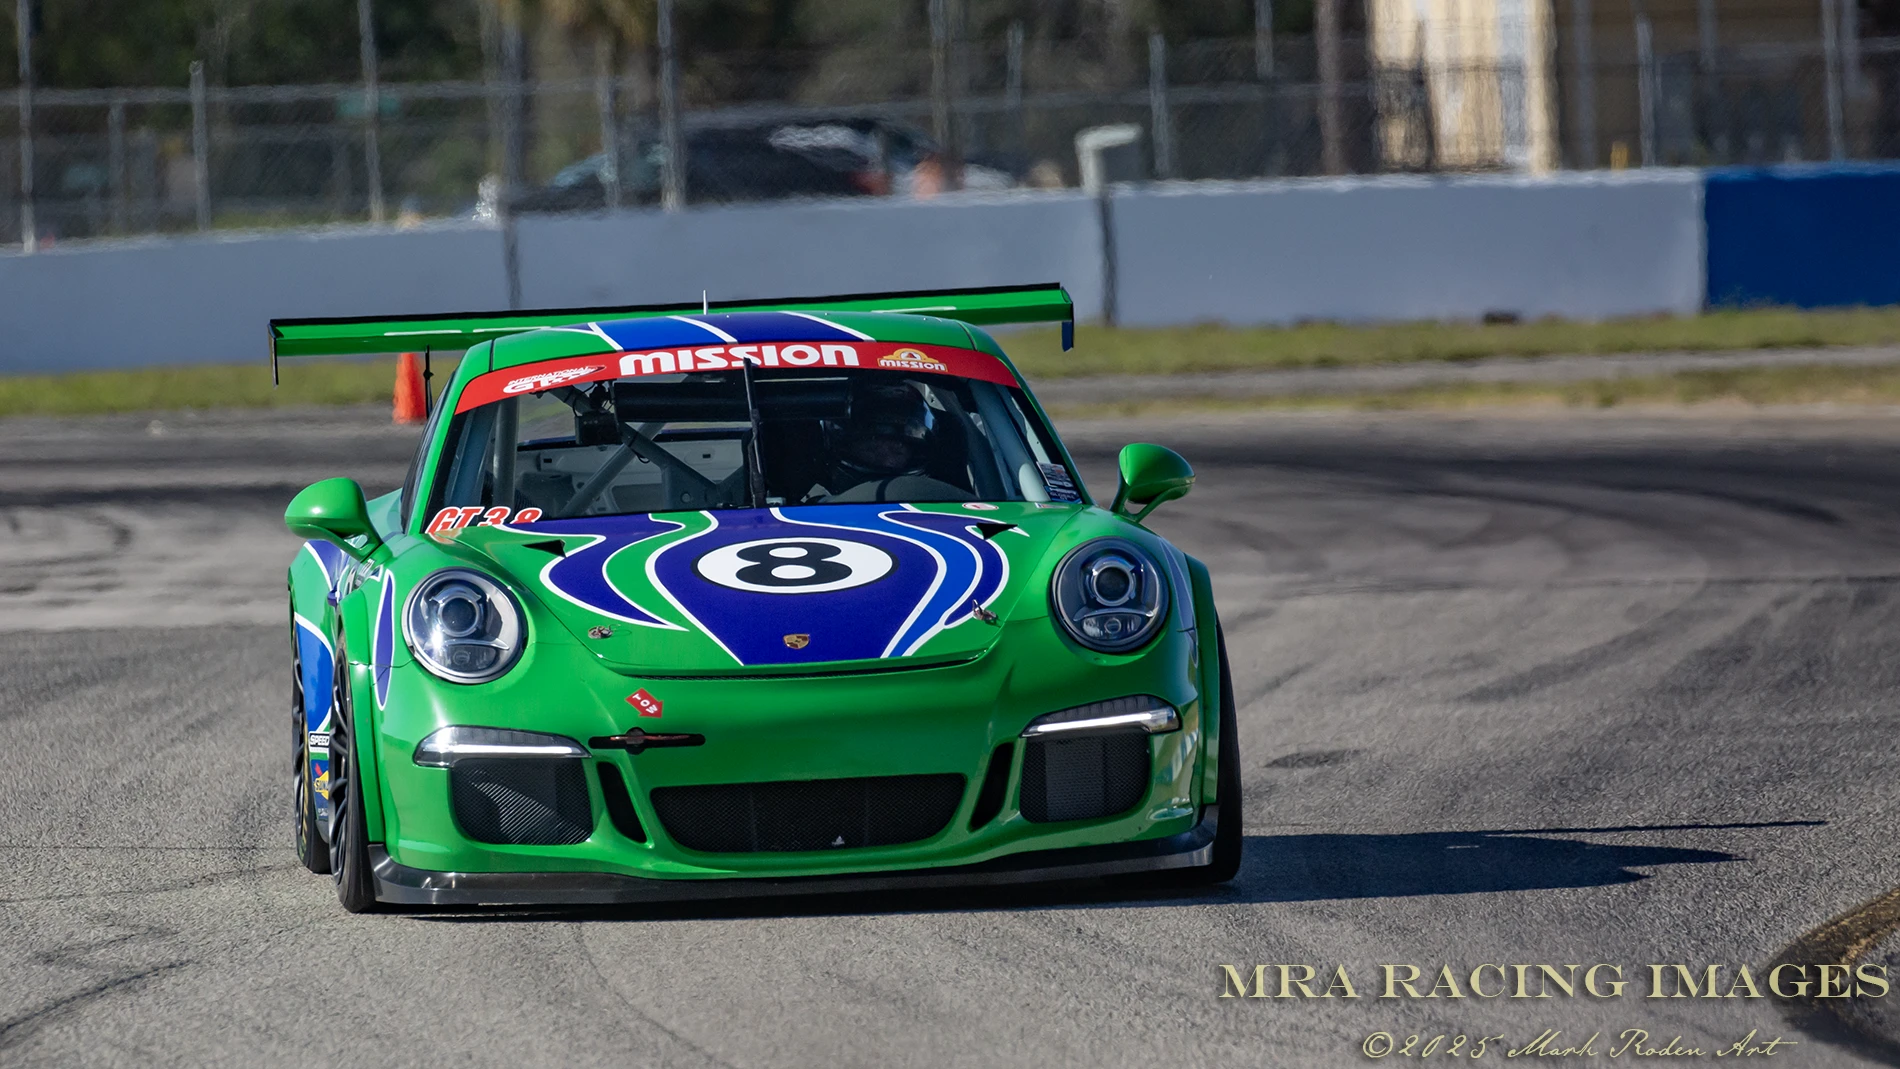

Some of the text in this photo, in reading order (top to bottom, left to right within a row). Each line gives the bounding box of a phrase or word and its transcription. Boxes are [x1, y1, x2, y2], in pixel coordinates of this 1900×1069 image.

[619, 344, 860, 376] MISSION
[879, 358, 946, 371] MISSION
[508, 366, 590, 385] INTERNATIONAL
[735, 542, 853, 587] 8
[632, 693, 658, 714] TOW
